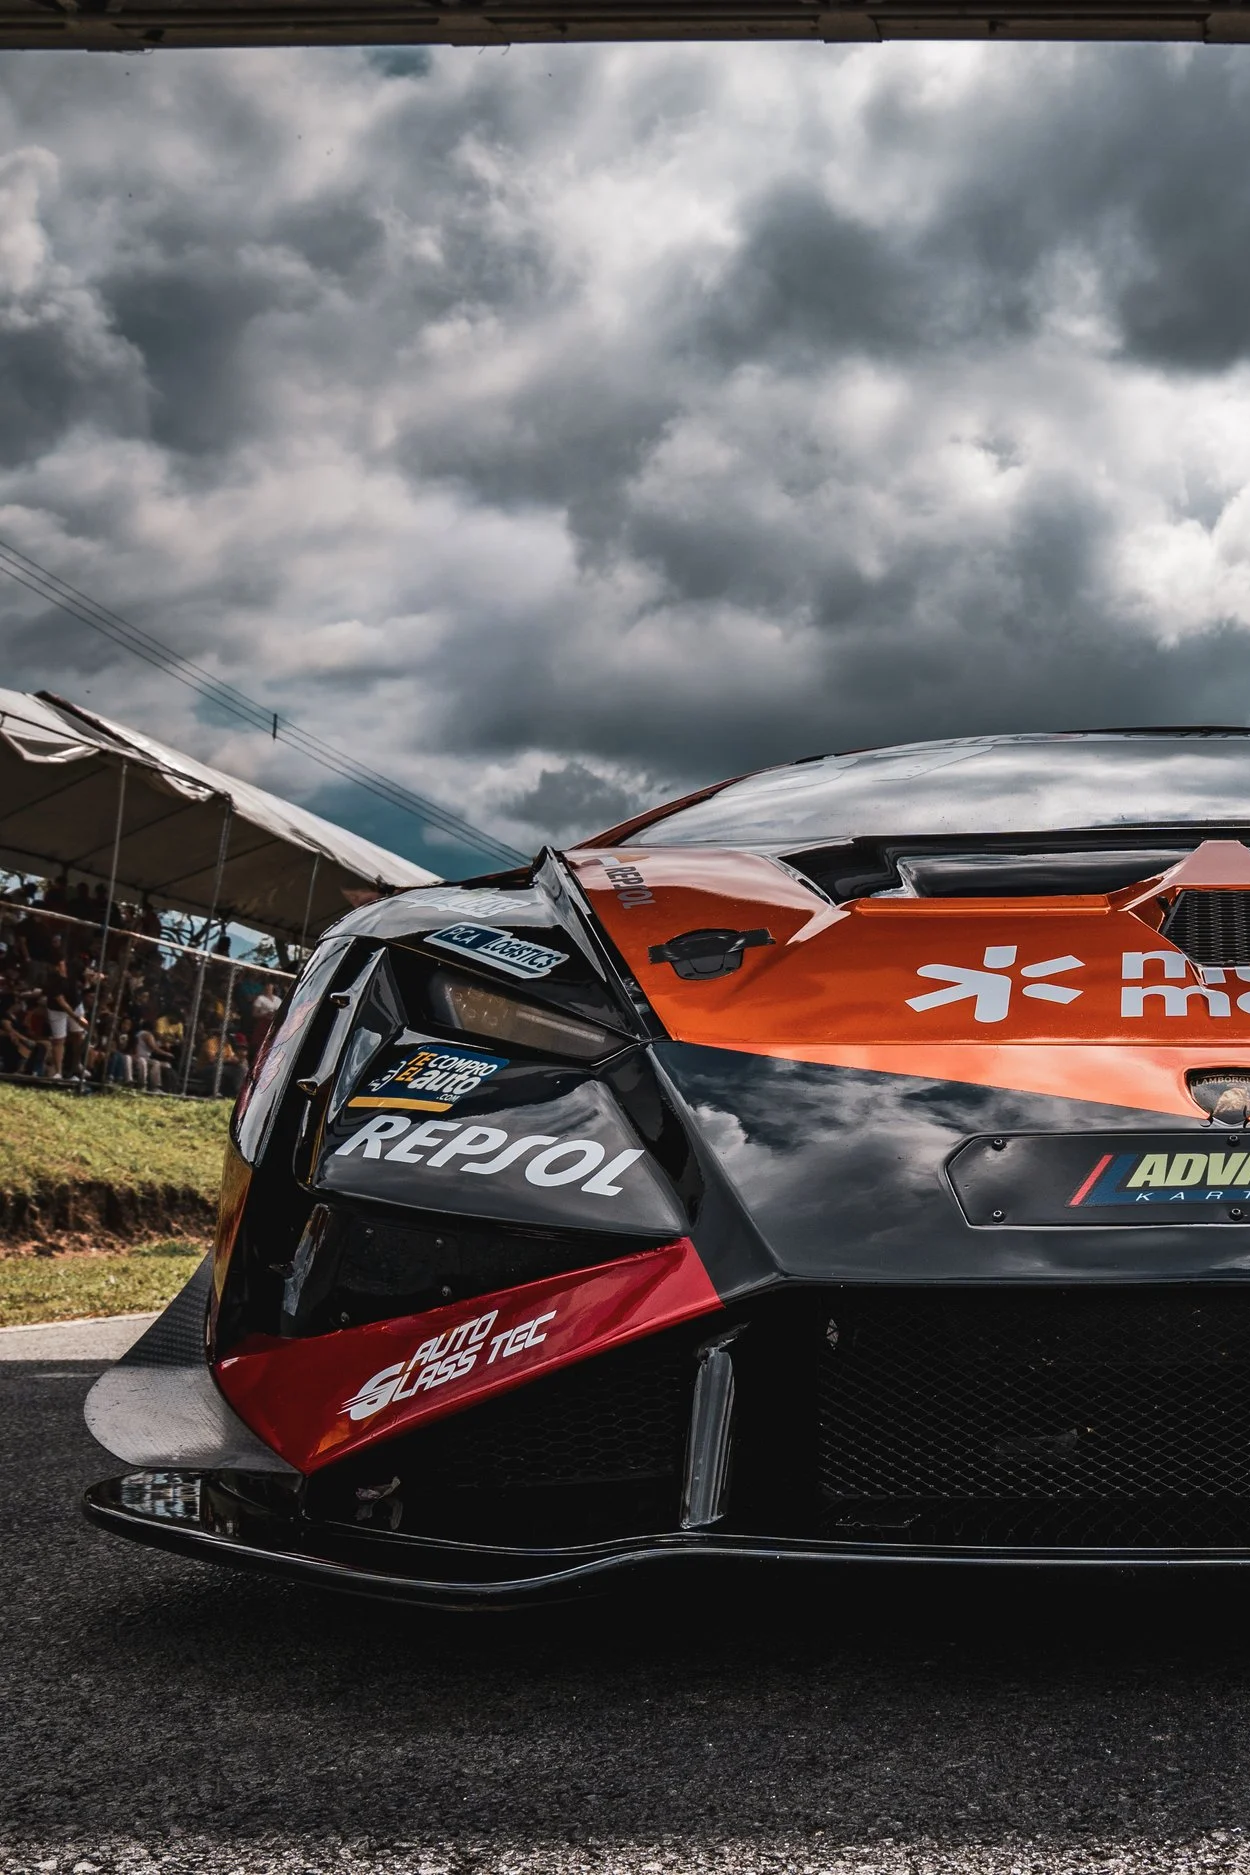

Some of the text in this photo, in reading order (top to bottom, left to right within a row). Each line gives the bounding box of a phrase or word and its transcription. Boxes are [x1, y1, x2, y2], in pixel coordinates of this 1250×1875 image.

[604, 866, 656, 910] REPSOL
[442, 927, 562, 969] PCA LOGISTICS
[394, 1067, 482, 1095] EL auto
[408, 1051, 498, 1077] TE COMPRO
[335, 1114, 645, 1197] REPSOL
[408, 1309, 499, 1372] AUTO
[338, 1309, 557, 1420] GLASS TEC
